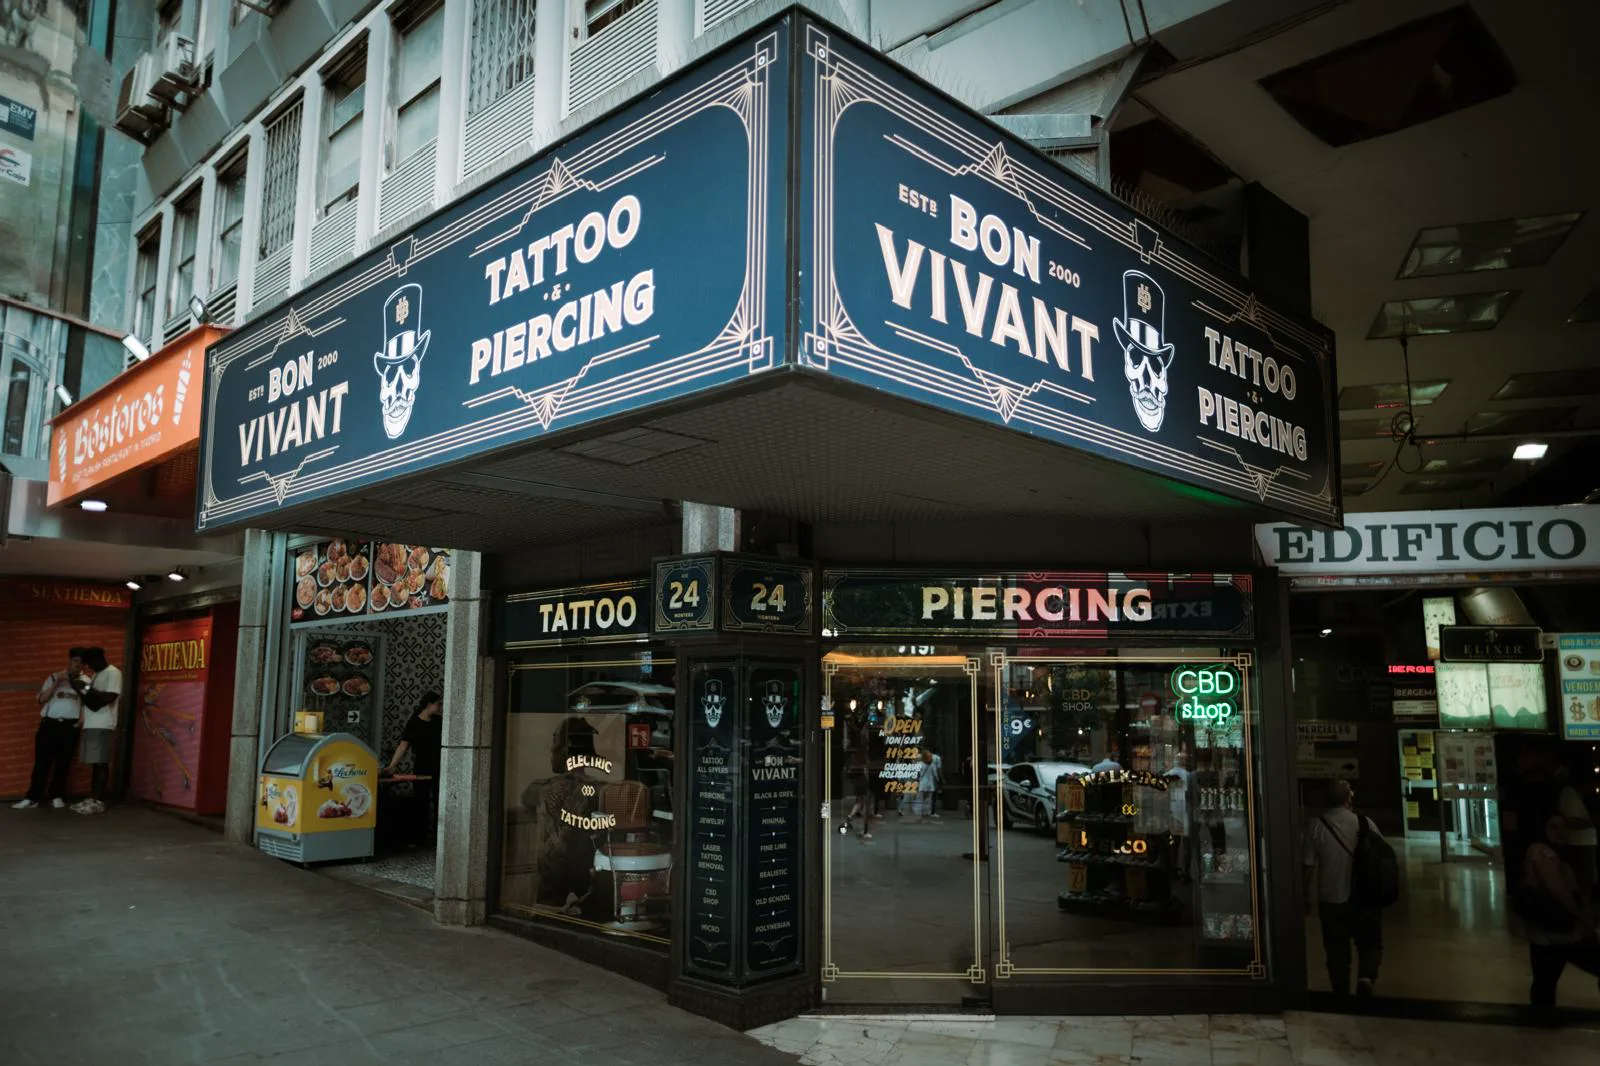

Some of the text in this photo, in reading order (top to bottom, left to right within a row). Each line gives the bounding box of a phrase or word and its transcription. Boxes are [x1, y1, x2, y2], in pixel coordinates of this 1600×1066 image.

[485, 194, 641, 305] TATTOO
[950, 193, 1041, 284] BON
[1049, 260, 1081, 289] 2000
[874, 222, 1100, 382] VIVANT
[469, 269, 655, 385] PIERCING
[268, 350, 314, 403] BON
[317, 350, 338, 370] 2000
[1204, 325, 1296, 400] TATTOO
[239, 380, 348, 467] VIVANT
[1198, 386, 1307, 461] PIERCING
[1273, 518, 1586, 564] EDIFICIO
[31, 585, 122, 602] SEXTIENDA
[669, 579, 700, 610] 24
[750, 582, 787, 612] 24
[921, 586, 1153, 622] PIERCING
[539, 595, 637, 633] TATTOO
[141, 638, 206, 672] SEXTIENDA
[1062, 689, 1090, 701] CBD
[1178, 670, 1234, 693] CBD
[1062, 702, 1091, 712] SHOP
[1182, 696, 1231, 724] shop
[701, 756, 724, 765] TATTOO
[752, 767, 796, 780] VIVANT
[560, 808, 617, 830] TATTOOING
[700, 852, 723, 861] TATTOO
